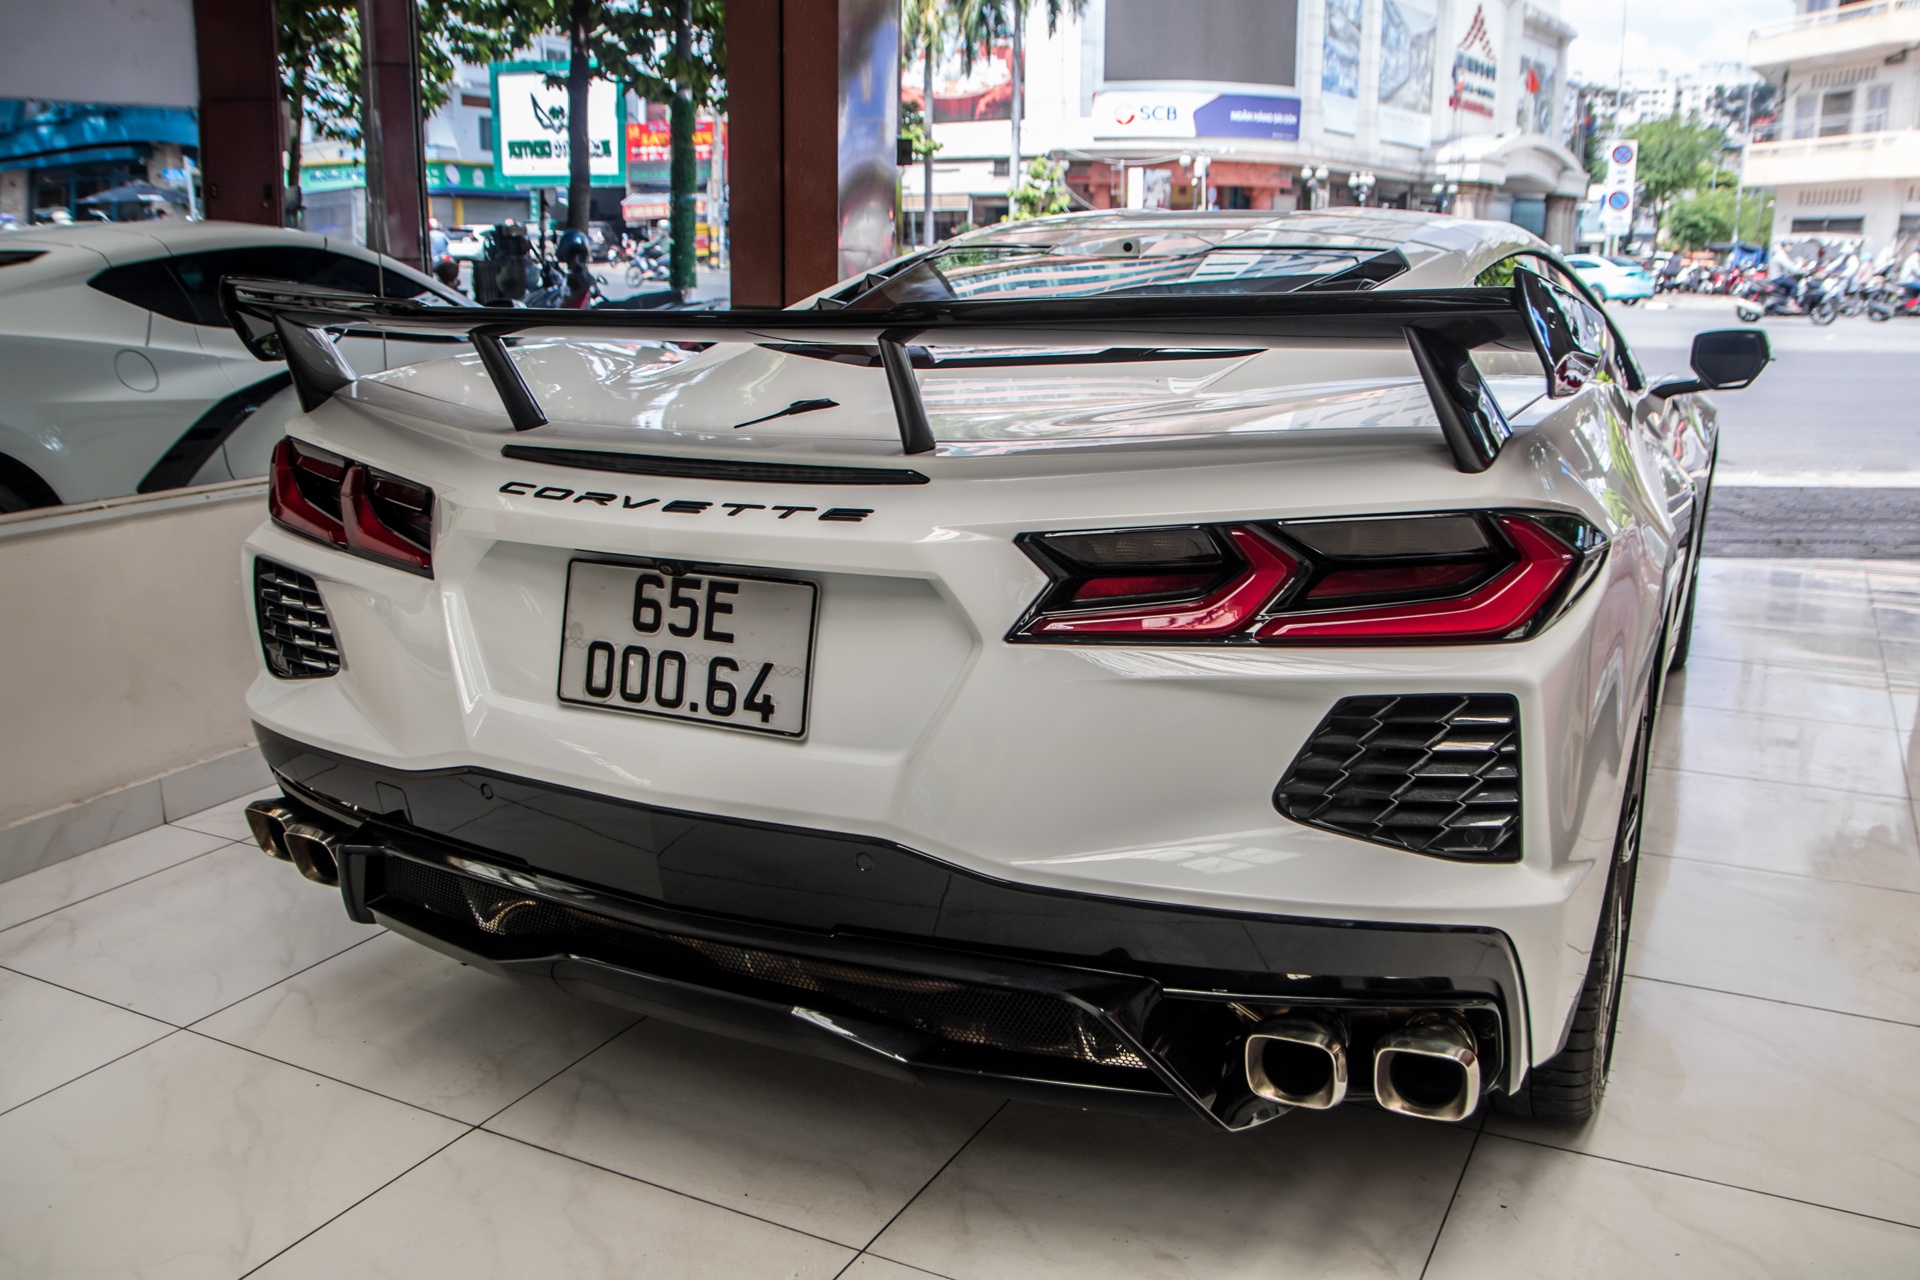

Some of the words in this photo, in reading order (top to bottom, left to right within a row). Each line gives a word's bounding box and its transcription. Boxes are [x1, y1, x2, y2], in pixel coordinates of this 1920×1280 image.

[1140, 105, 1177, 121] SCB
[498, 481, 875, 522] CORVETTE
[632, 574, 740, 644] 65E
[585, 640, 776, 723] 000.64
